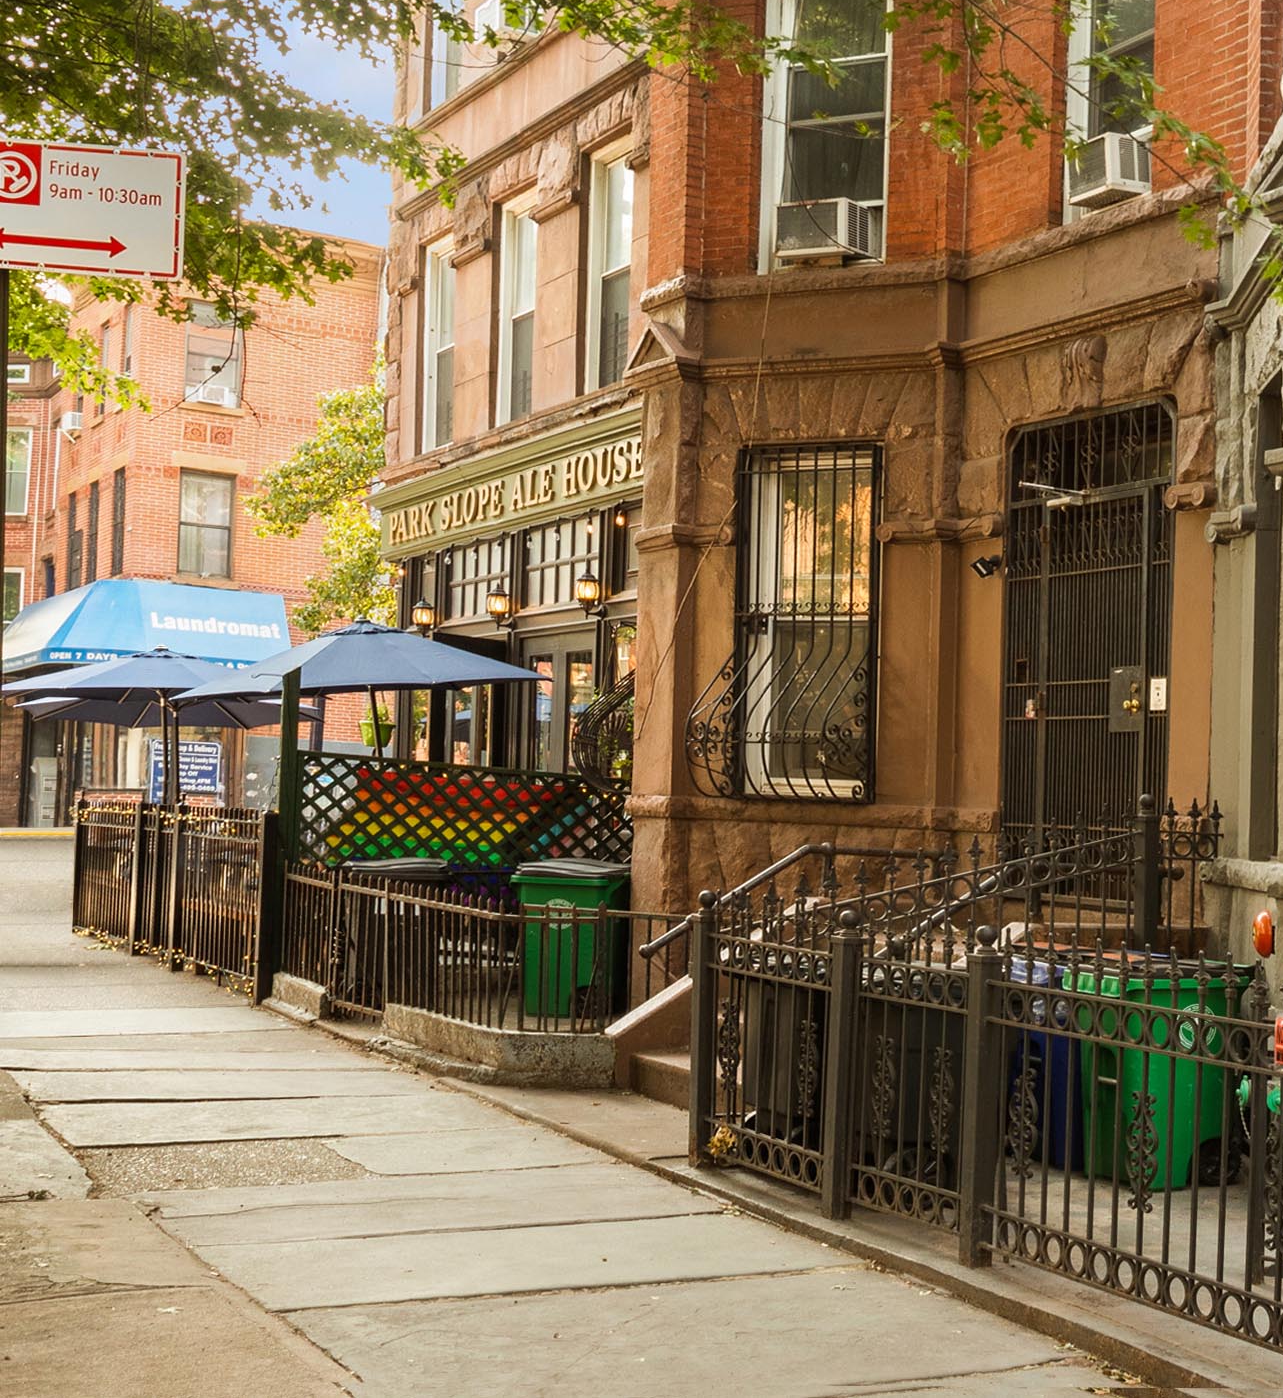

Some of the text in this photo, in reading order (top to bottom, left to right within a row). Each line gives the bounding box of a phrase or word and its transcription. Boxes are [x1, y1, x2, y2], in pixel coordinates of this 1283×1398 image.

[49, 160, 100, 181] Friday
[49, 183, 83, 200] 9am
[98, 187, 162, 206] 10:30am
[388, 434, 644, 545] PARK SLOPE ALE HOUSE
[150, 611, 282, 640] Laundromat
[49, 651, 118, 661] OPEN 7 DAYS
